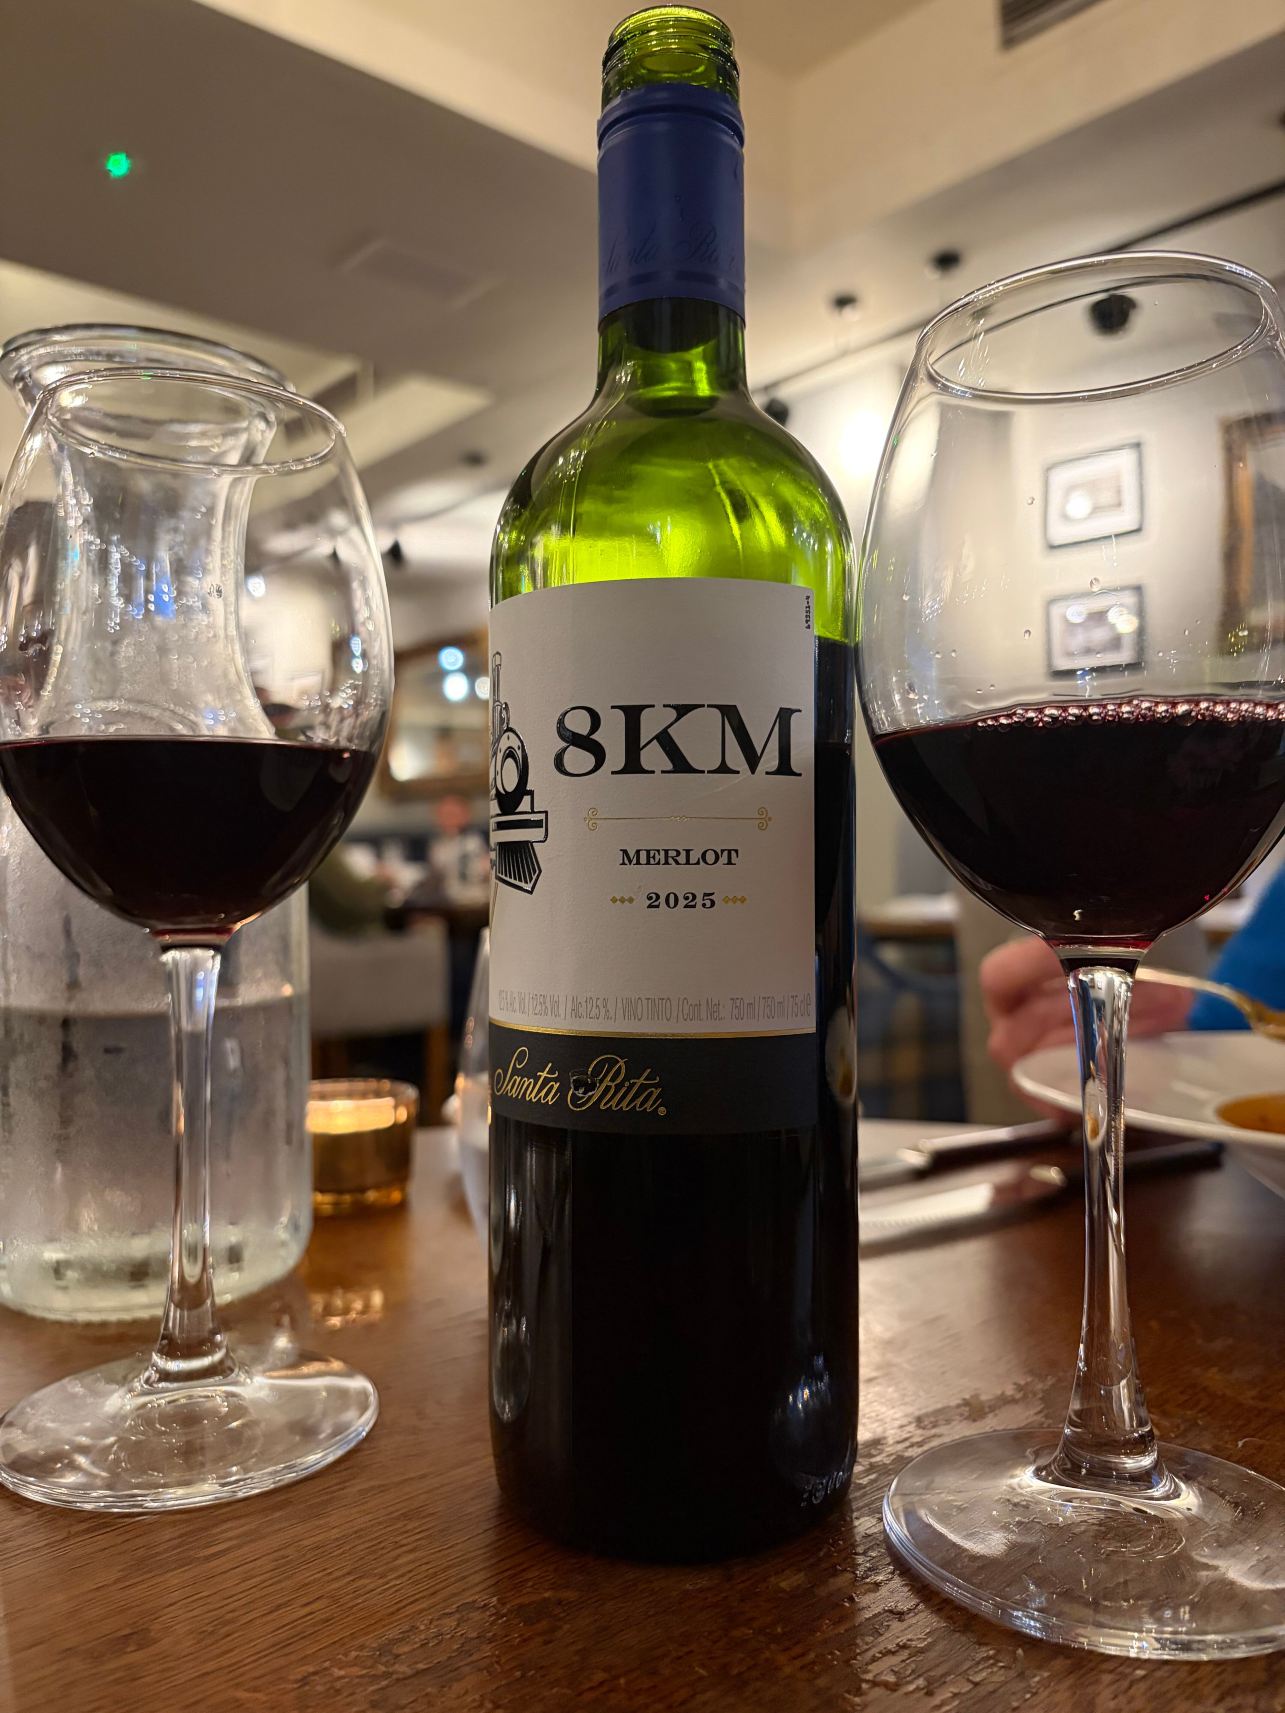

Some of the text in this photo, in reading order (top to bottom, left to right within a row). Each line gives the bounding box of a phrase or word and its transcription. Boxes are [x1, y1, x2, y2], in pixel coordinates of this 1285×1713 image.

[553, 703, 803, 777] 8KM
[619, 848, 739, 866] MERLOT
[646, 891, 716, 909] 2025
[621, 997, 643, 1021] VINO
[645, 997, 671, 1021] TINTO
[729, 997, 744, 1020] 750
[494, 1047, 663, 1112] Santa Rita
